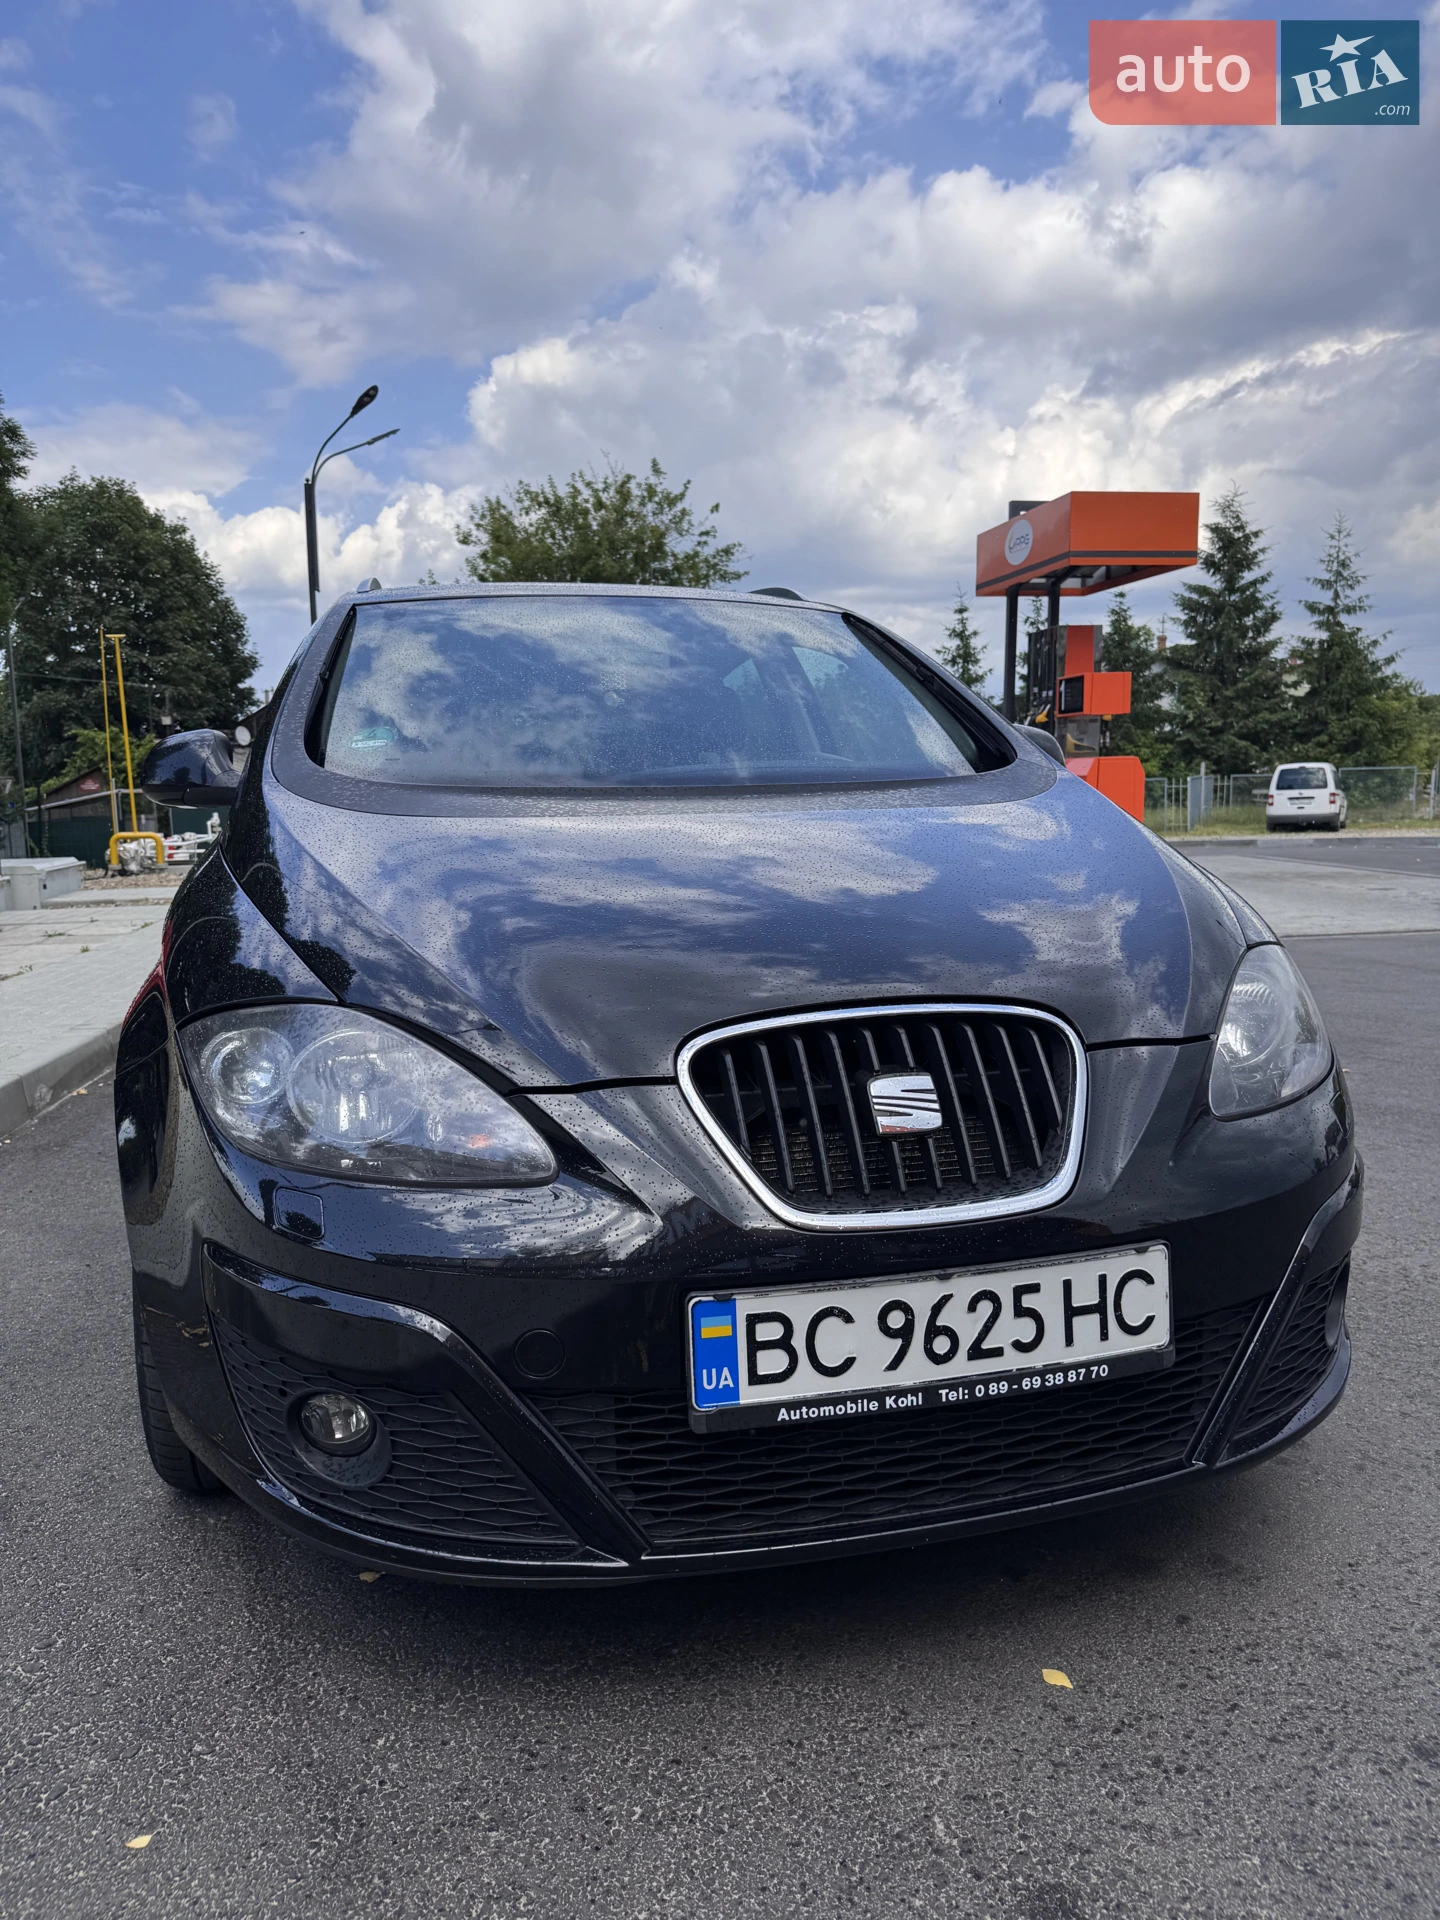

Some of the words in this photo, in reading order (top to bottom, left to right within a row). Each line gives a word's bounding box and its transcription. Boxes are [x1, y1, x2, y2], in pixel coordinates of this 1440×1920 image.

[745, 1305, 857, 1387] BC
[877, 1282, 1045, 1372] 9625
[1062, 1268, 1156, 1348] HC
[702, 1366, 735, 1390] UA
[777, 1399, 879, 1422] Automobile
[885, 1392, 923, 1409] Kohl
[938, 1387, 969, 1402] Tel:
